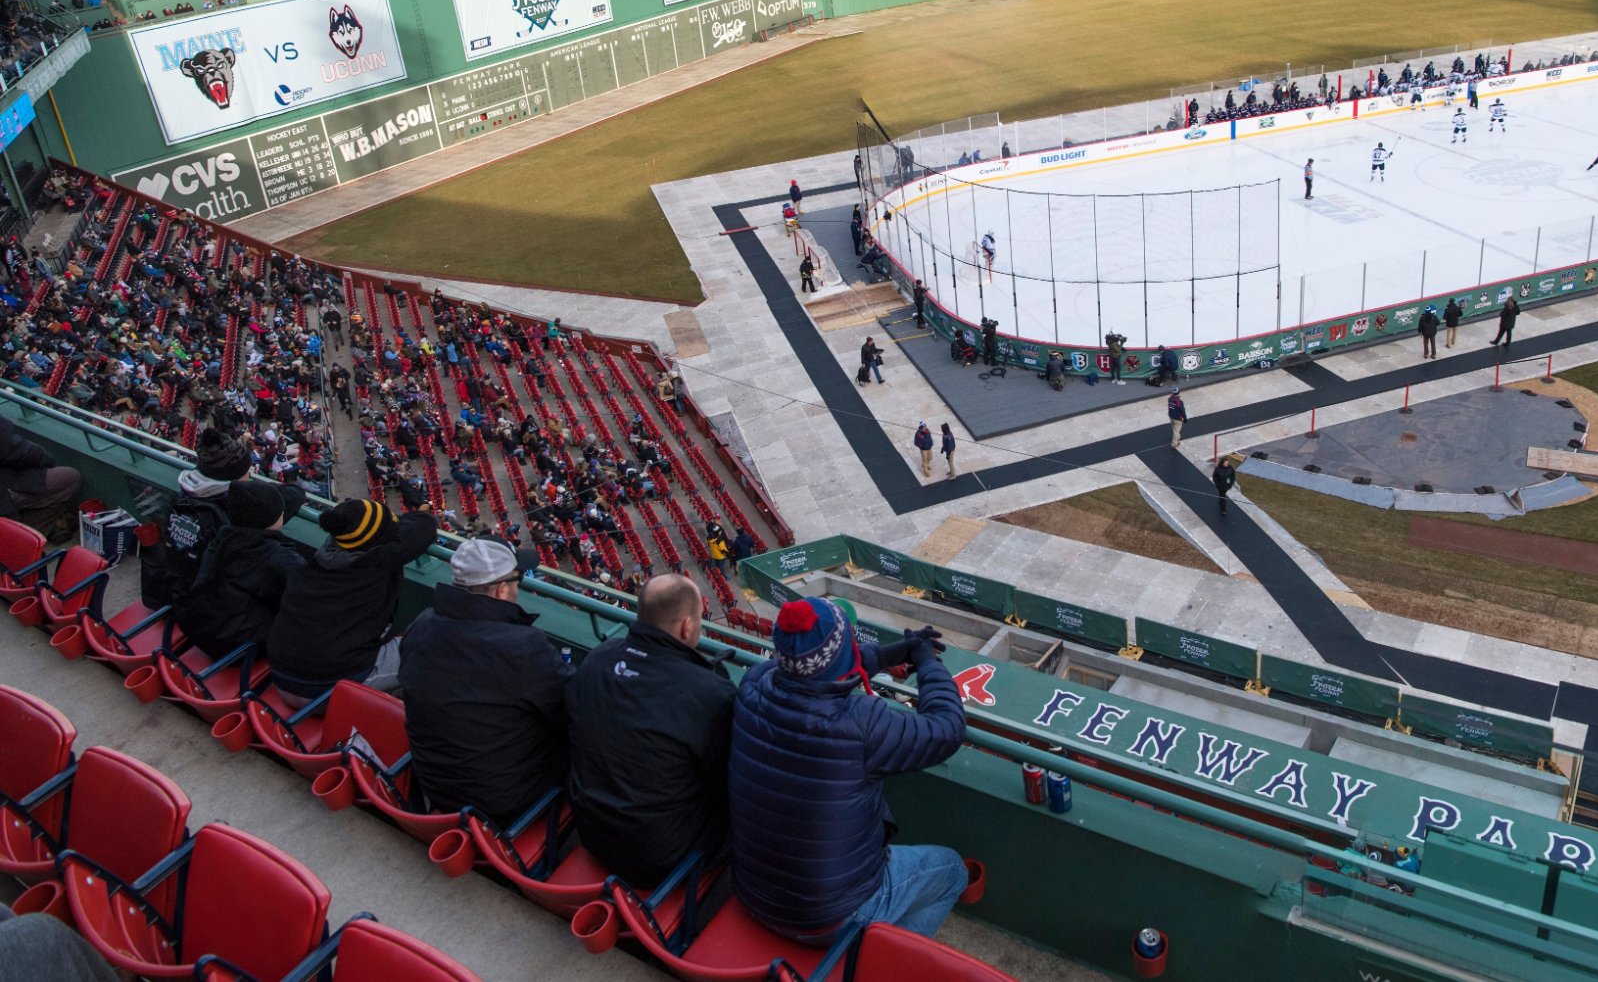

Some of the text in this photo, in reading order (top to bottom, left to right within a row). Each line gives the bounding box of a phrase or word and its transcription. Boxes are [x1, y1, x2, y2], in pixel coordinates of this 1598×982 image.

[520, 0, 558, 19] FENWAY
[803, 1, 817, 9] 379
[634, 16, 677, 33] NATIONAL LEAGUE
[701, 5, 720, 25] F.W.
[156, 26, 248, 72] MAINE
[264, 42, 298, 64] VS
[550, 38, 601, 58] AMERICAN LEAGUE
[320, 50, 387, 84] UCONN
[453, 61, 521, 86] FENWAY PARK
[267, 125, 307, 142] HOCKEY EAST
[256, 145, 283, 159] LEADERS
[307, 134, 320, 144] PTS
[258, 154, 290, 168] KELLEHER
[1040, 149, 1086, 164] BUD LIGHT
[172, 152, 240, 195] CVS
[264, 175, 285, 187] BROWN
[267, 181, 298, 196] THOMPSON
[270, 198, 279, 206] AS
[279, 194, 288, 202] OF
[289, 191, 300, 200] JAN
[1238, 346, 1273, 361] BABSON
[1033, 689, 1377, 823] FENWAY
